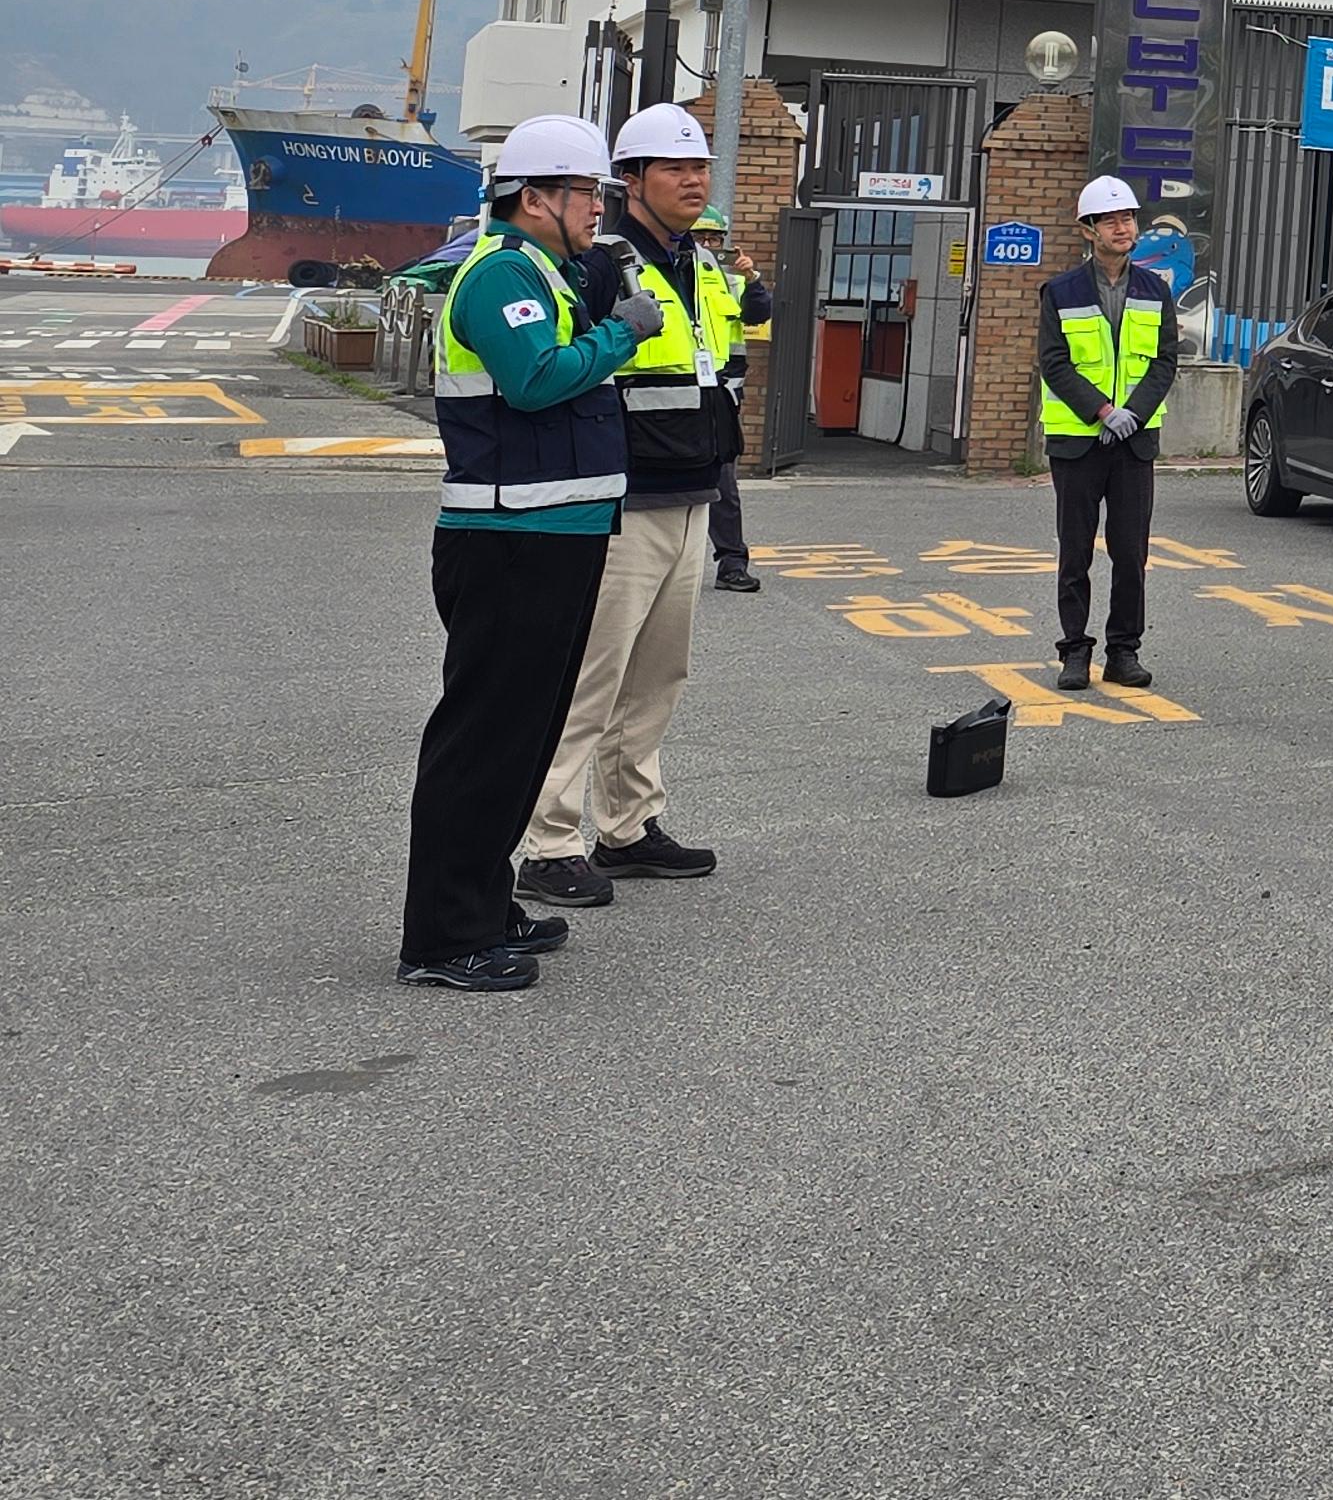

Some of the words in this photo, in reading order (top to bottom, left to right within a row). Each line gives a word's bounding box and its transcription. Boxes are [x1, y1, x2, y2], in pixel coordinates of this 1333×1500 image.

[282, 140, 361, 163] HONGYUN
[363, 148, 433, 169] BAOYUE
[993, 243, 1033, 260] 409
